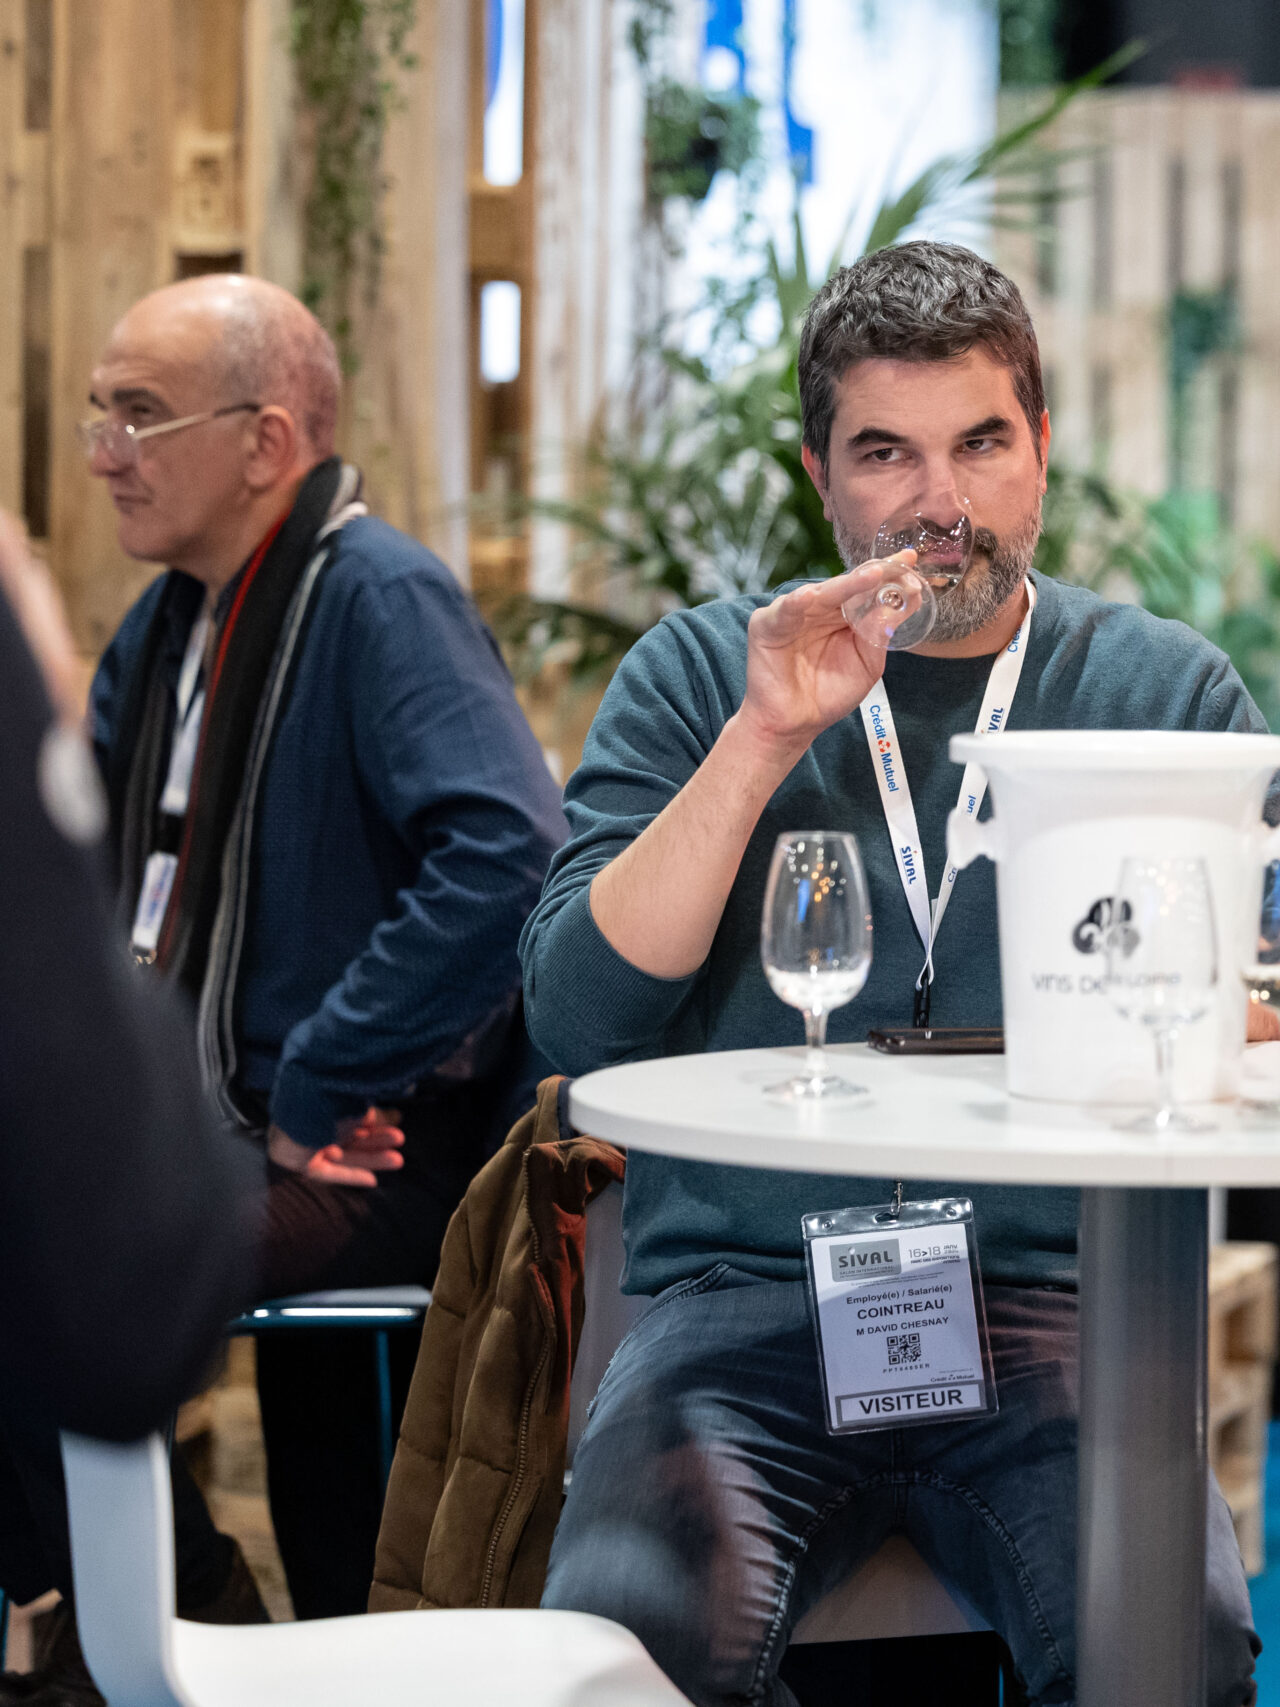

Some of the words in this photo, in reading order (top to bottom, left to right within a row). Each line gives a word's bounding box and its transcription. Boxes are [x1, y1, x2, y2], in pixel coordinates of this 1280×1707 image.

[869, 705, 887, 740] Crédit
[880, 752, 900, 793] Mutuel
[900, 846, 917, 886] SIVAL
[838, 1250, 894, 1269] SIVAL
[846, 1291, 900, 1305] Employé(e)
[907, 1284, 953, 1297] Salarié(e)
[857, 1299, 945, 1320] COINTREAU
[856, 1327, 865, 1337] M
[867, 1323, 898, 1335] DAVID
[900, 1316, 949, 1331] CHESNAY
[859, 1389, 963, 1415] VISITEUR
